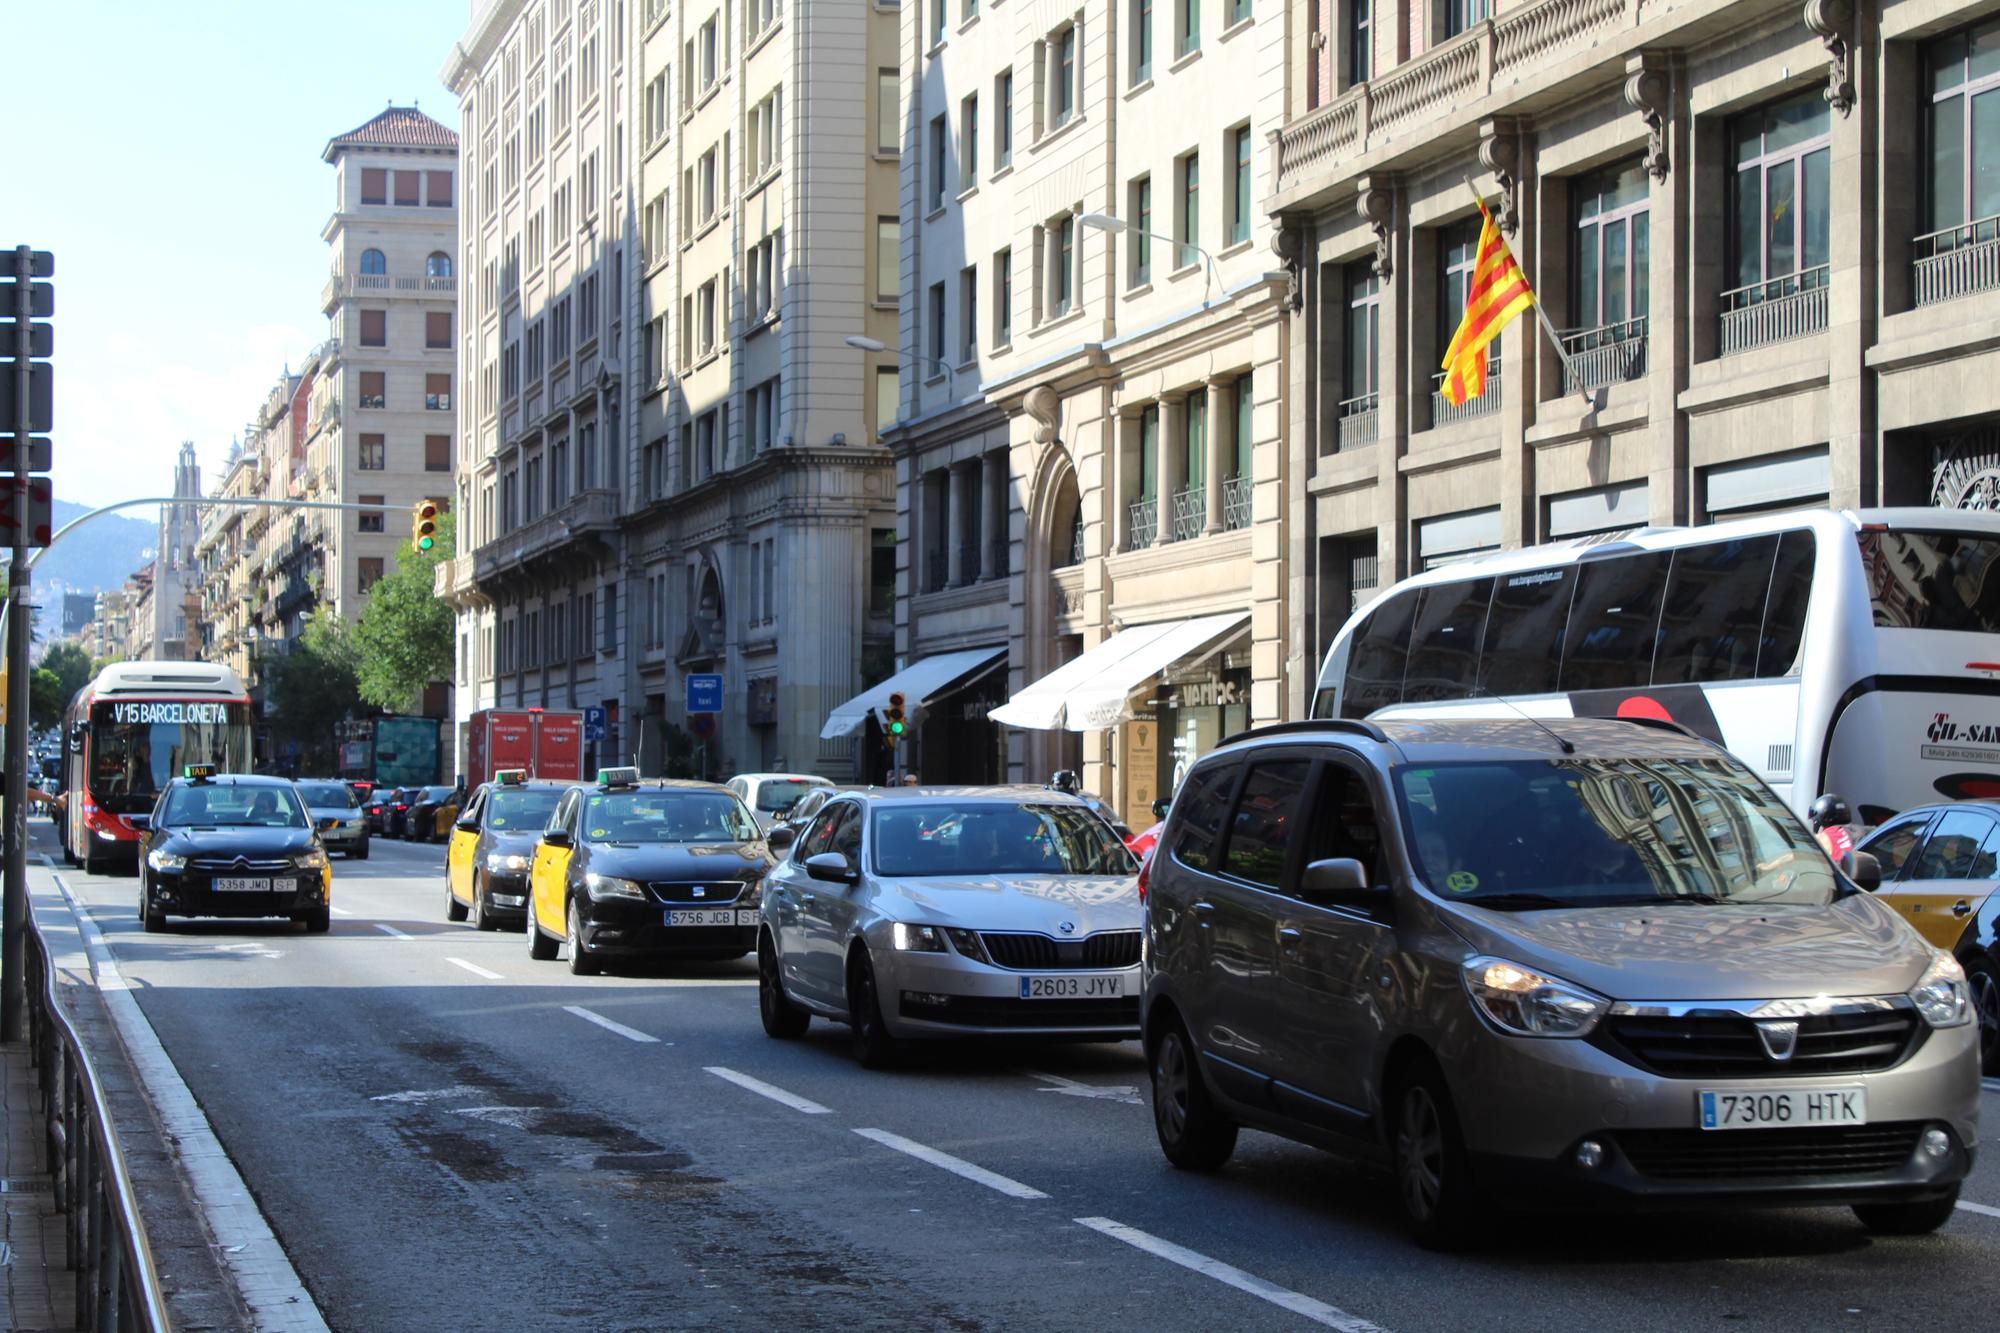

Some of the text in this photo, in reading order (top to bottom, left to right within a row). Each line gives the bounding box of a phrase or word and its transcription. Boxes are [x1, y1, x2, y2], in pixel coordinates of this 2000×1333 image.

[1183, 671, 1236, 707] veritas
[115, 703, 227, 723] V15 BARCELONETA
[590, 710, 599, 722] P
[1131, 711, 1158, 720] eritas
[192, 767, 207, 776] TAXI
[219, 880, 245, 889] 5358
[672, 912, 704, 924] 5756
[709, 911, 730, 924] JCB
[1032, 978, 1118, 996] 2603 JYV
[1722, 1094, 1792, 1124] 7306
[1807, 1092, 1857, 1121] HTK
